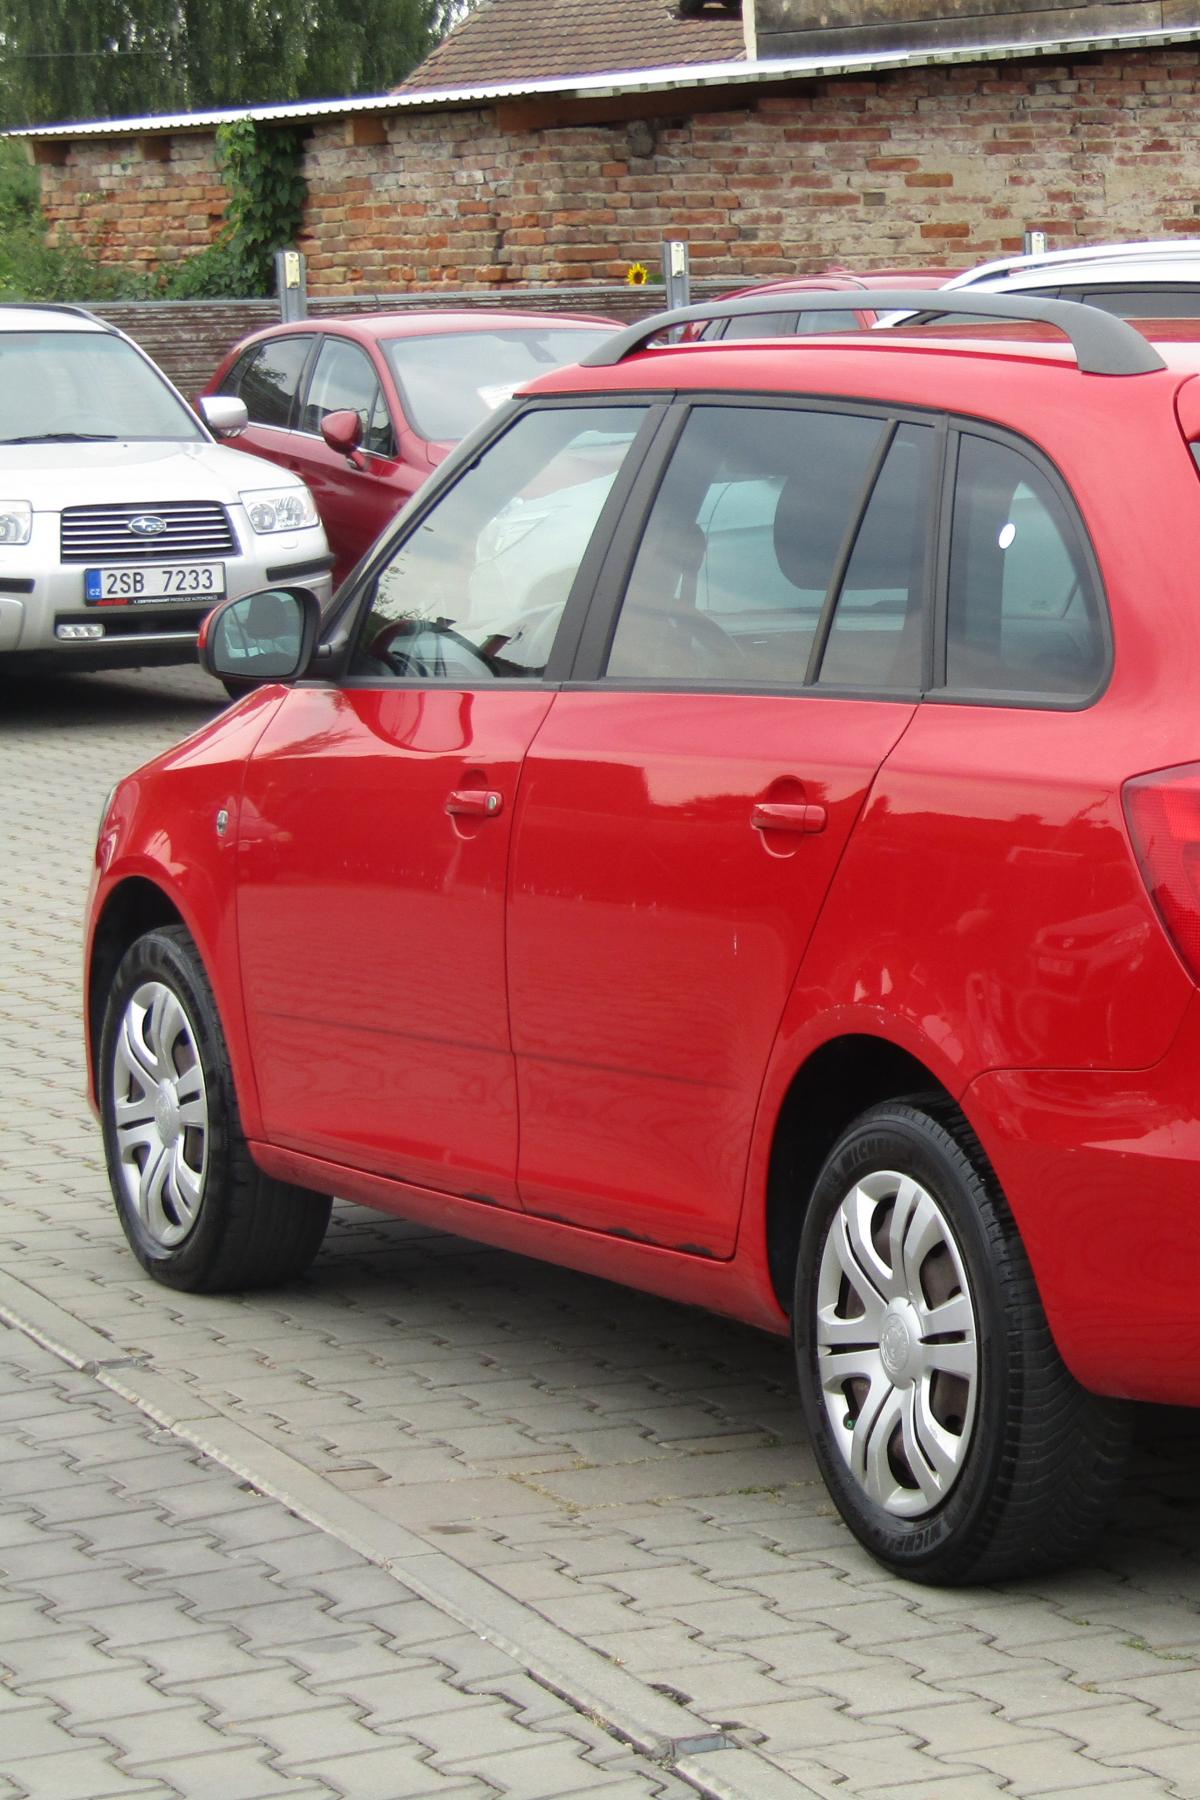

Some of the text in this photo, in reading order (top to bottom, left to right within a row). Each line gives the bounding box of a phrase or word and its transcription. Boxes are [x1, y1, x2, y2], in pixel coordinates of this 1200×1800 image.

[106, 568, 214, 595] 2SB 7233
[89, 588, 101, 596] CZ
